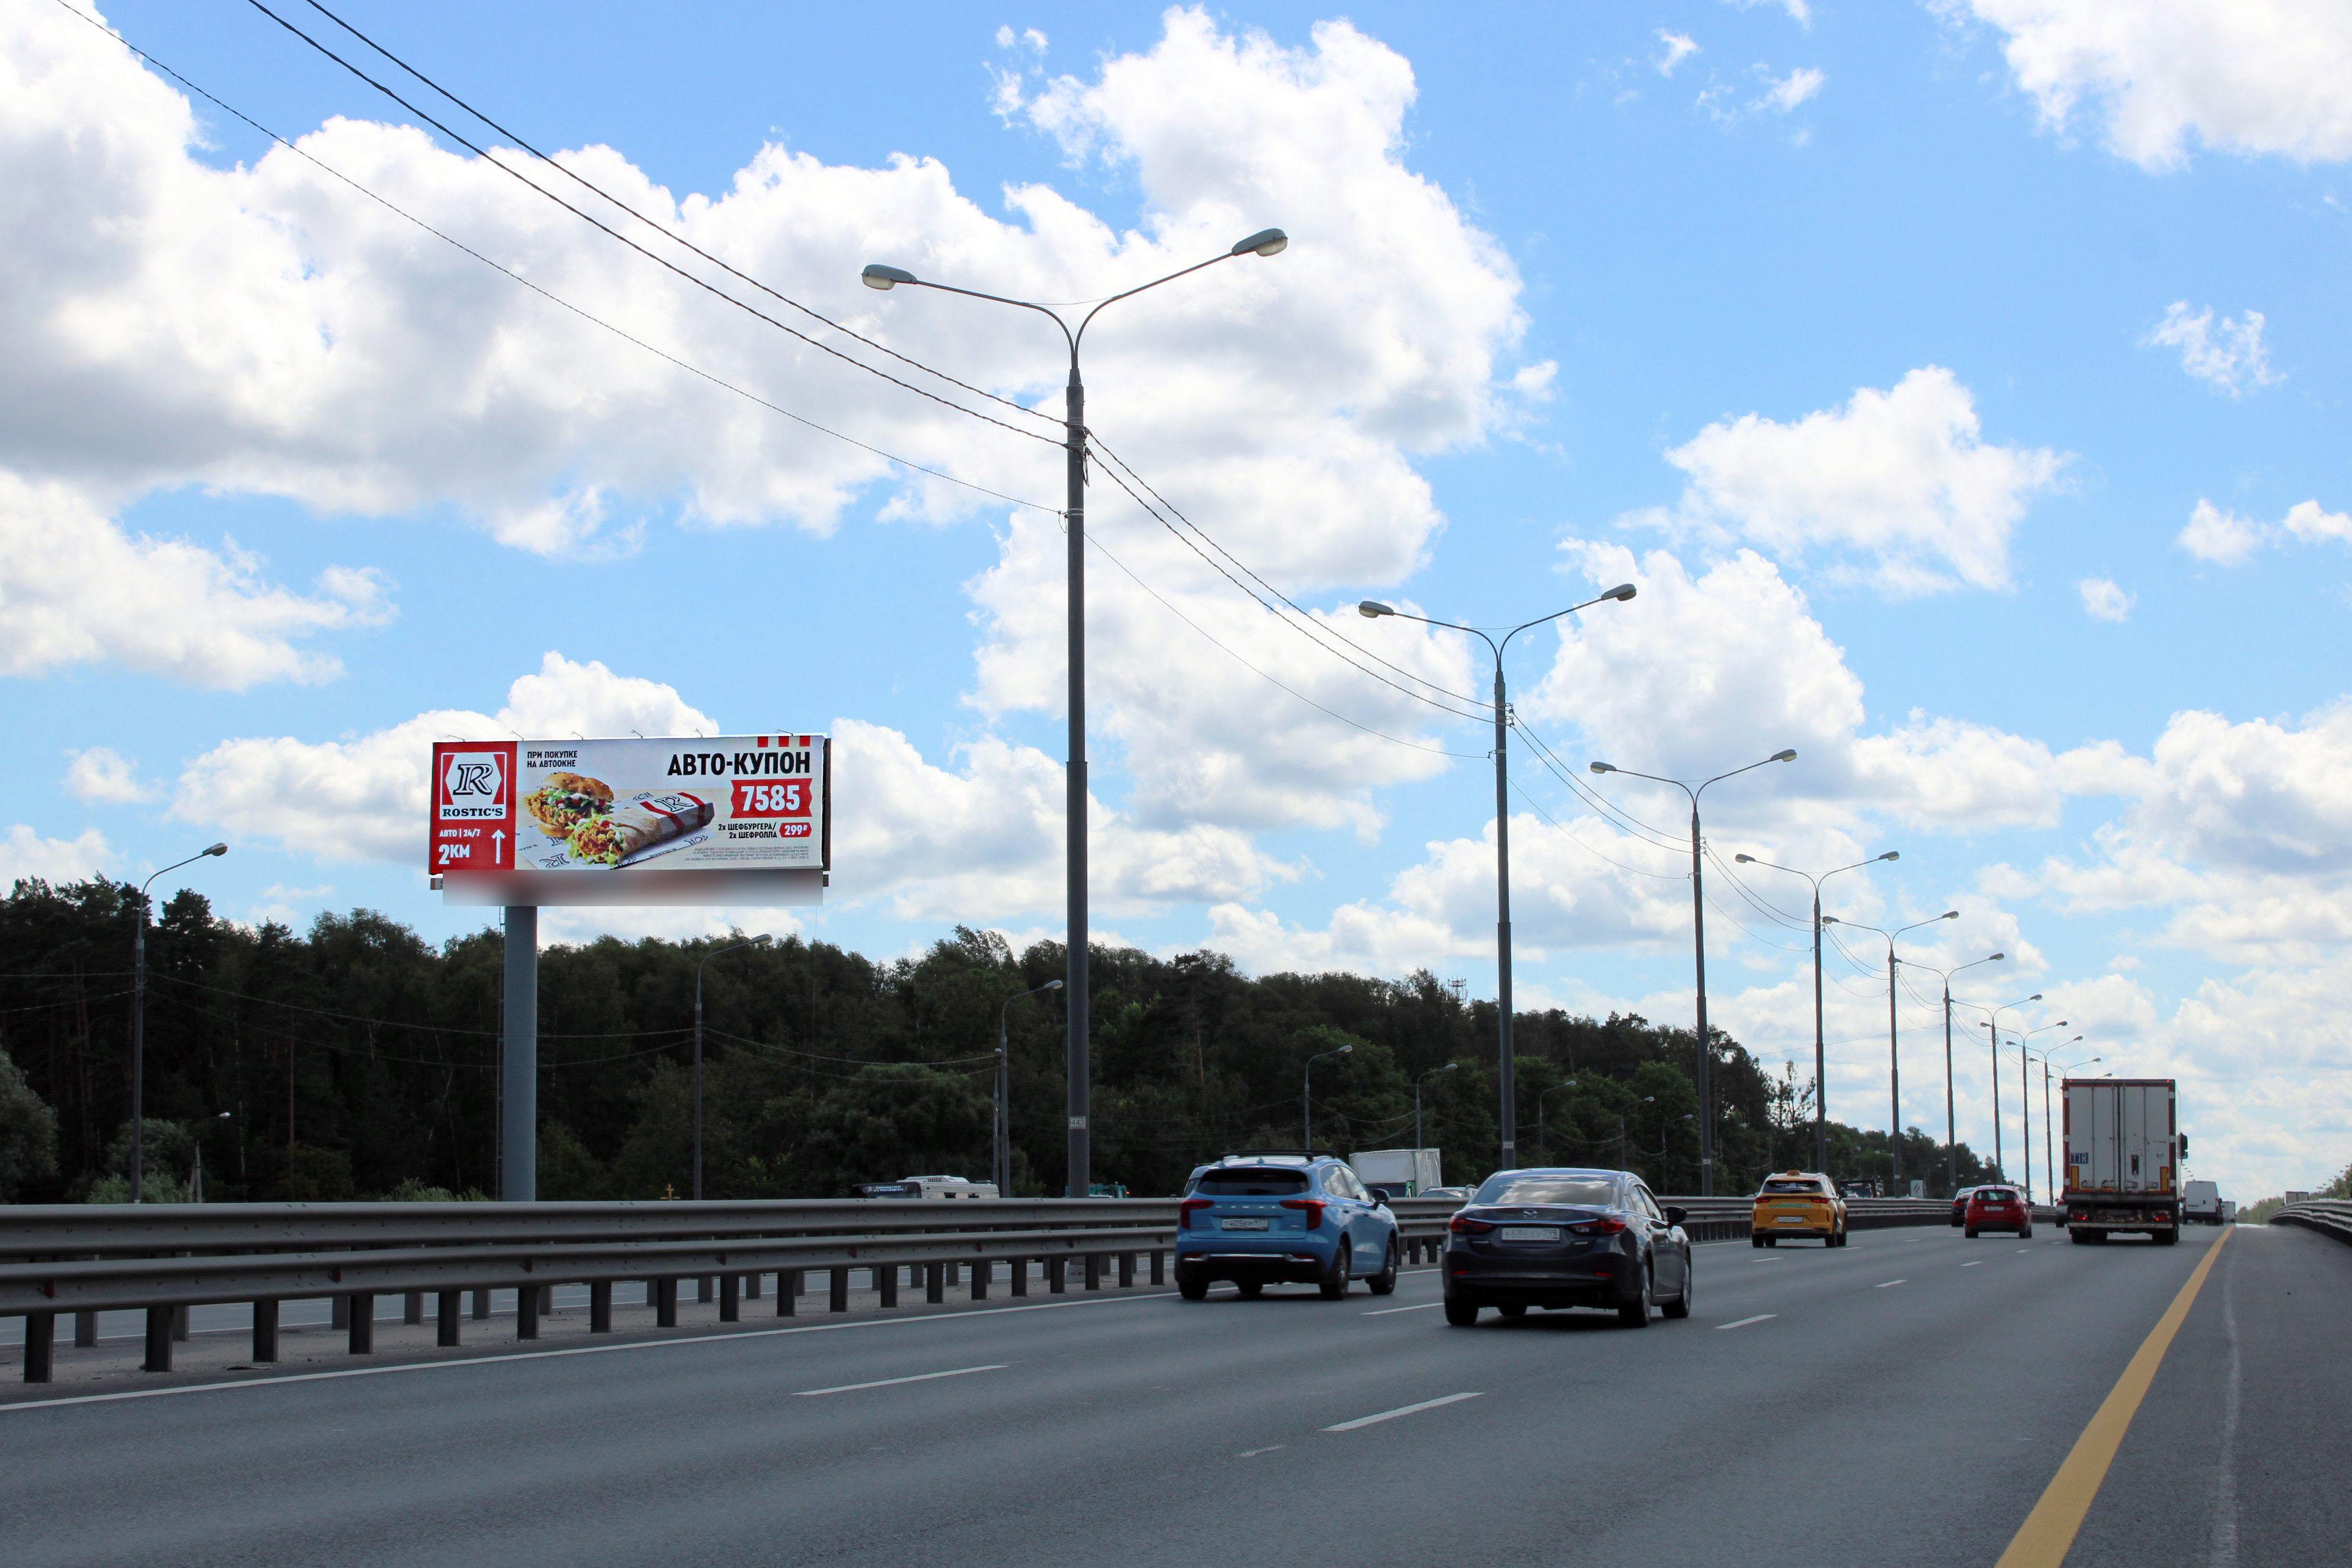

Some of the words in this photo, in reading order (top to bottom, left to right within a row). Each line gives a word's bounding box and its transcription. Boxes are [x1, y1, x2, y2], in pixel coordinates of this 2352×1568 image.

[539, 759, 576, 767] АВТООКНЕ
[667, 752, 811, 776] АВТО-КУПОН
[740, 785, 801, 812] 7585
[442, 808, 503, 817] ROSTIC'S
[463, 828, 481, 838] 24/7
[2072, 1153, 2088, 1163] TIR
